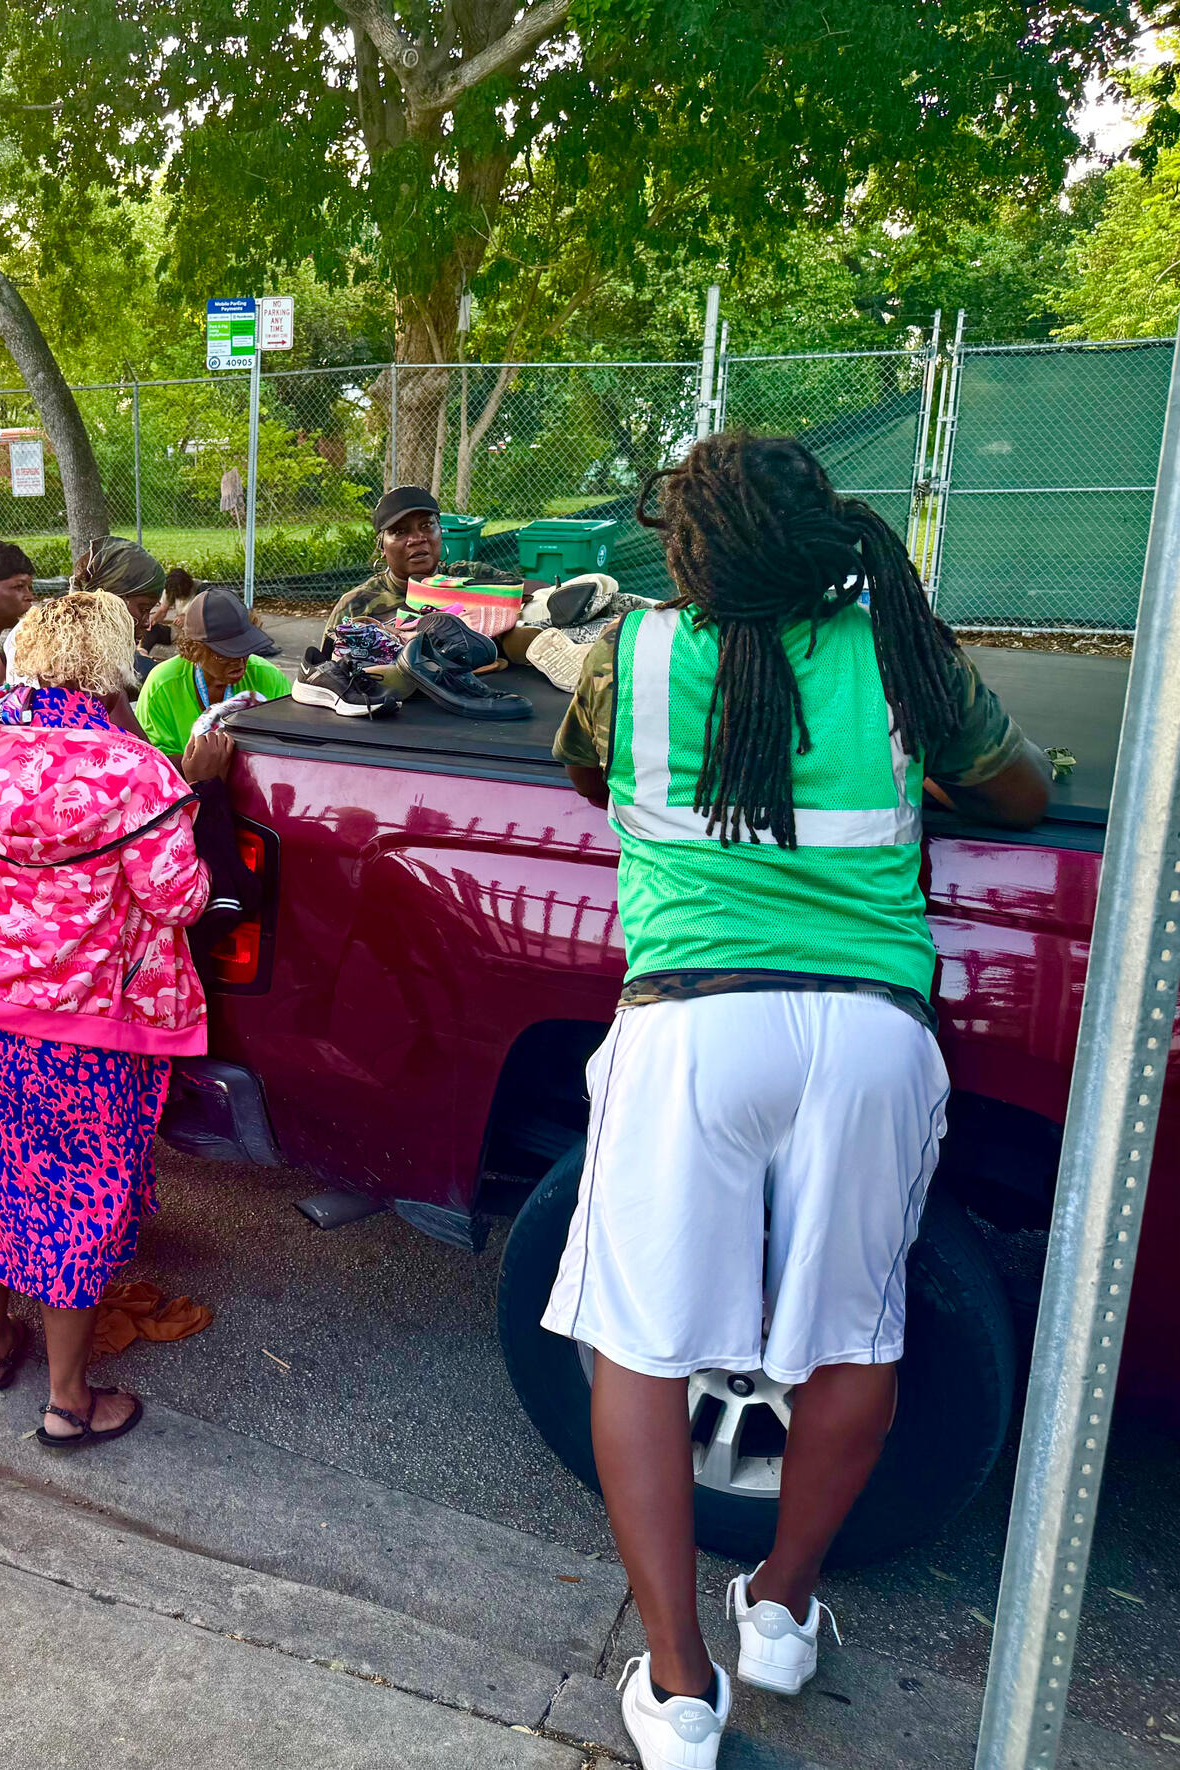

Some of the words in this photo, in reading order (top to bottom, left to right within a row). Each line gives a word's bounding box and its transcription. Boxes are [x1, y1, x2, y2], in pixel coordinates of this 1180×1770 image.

[272, 300, 282, 308] NO
[269, 325, 284, 333] TIME
[225, 358, 253, 367] 40905
[683, 1710, 701, 1718] NIKE
